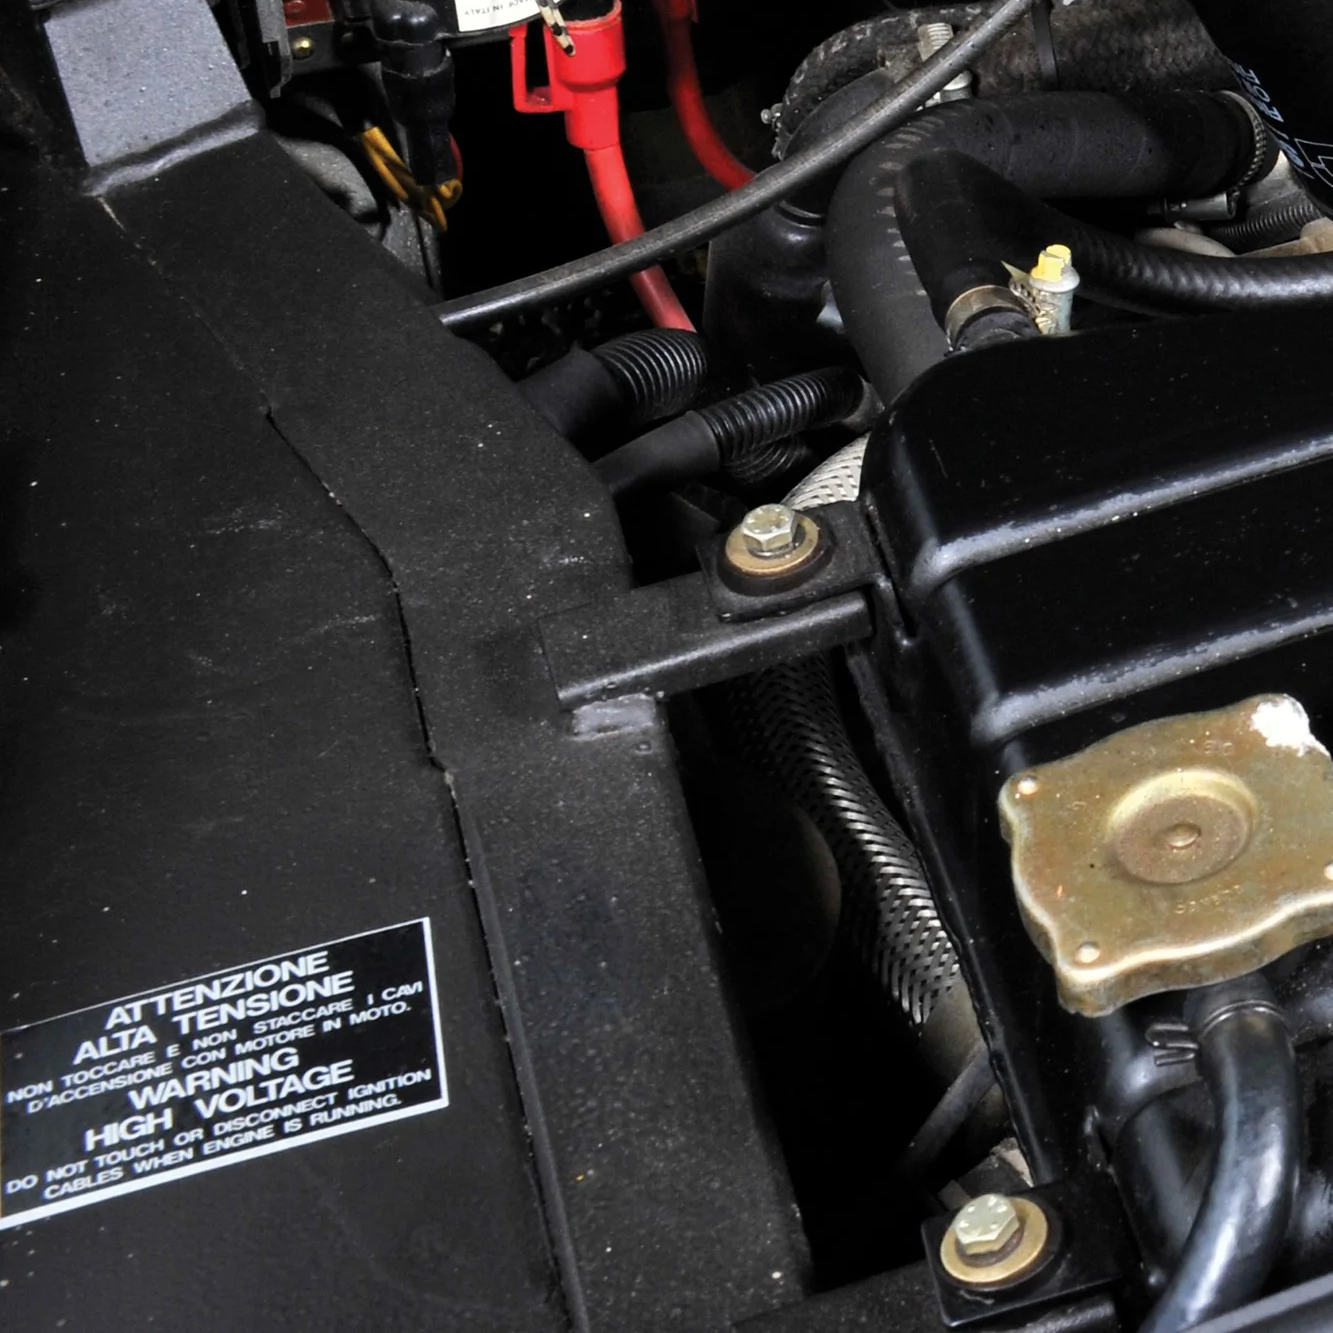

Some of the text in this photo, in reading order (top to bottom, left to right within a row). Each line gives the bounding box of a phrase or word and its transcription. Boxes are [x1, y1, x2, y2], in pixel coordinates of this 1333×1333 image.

[72, 970, 354, 1065] ALTA TENSIONE
[104, 951, 330, 1030] ATTENZIONE
[7, 1079, 54, 1104] NON
[60, 1052, 156, 1088] TOCCARE
[166, 1044, 181, 1057] E
[192, 1028, 238, 1050] NON
[252, 999, 354, 1035] STACCARE
[381, 981, 424, 1002] CAVI
[26, 1002, 412, 1114] D'ACCENSIONE CON MOTORE IN MOTO.
[127, 1046, 300, 1111] WARNING
[5, 1068, 432, 1195] DO NOT TOUCH OR DISCONNECT IGNITION
[43, 1094, 402, 1200] CABLES WHEN ENGINE IS RUNNING.
[83, 1059, 354, 1152] HIGH VOLTAGE
